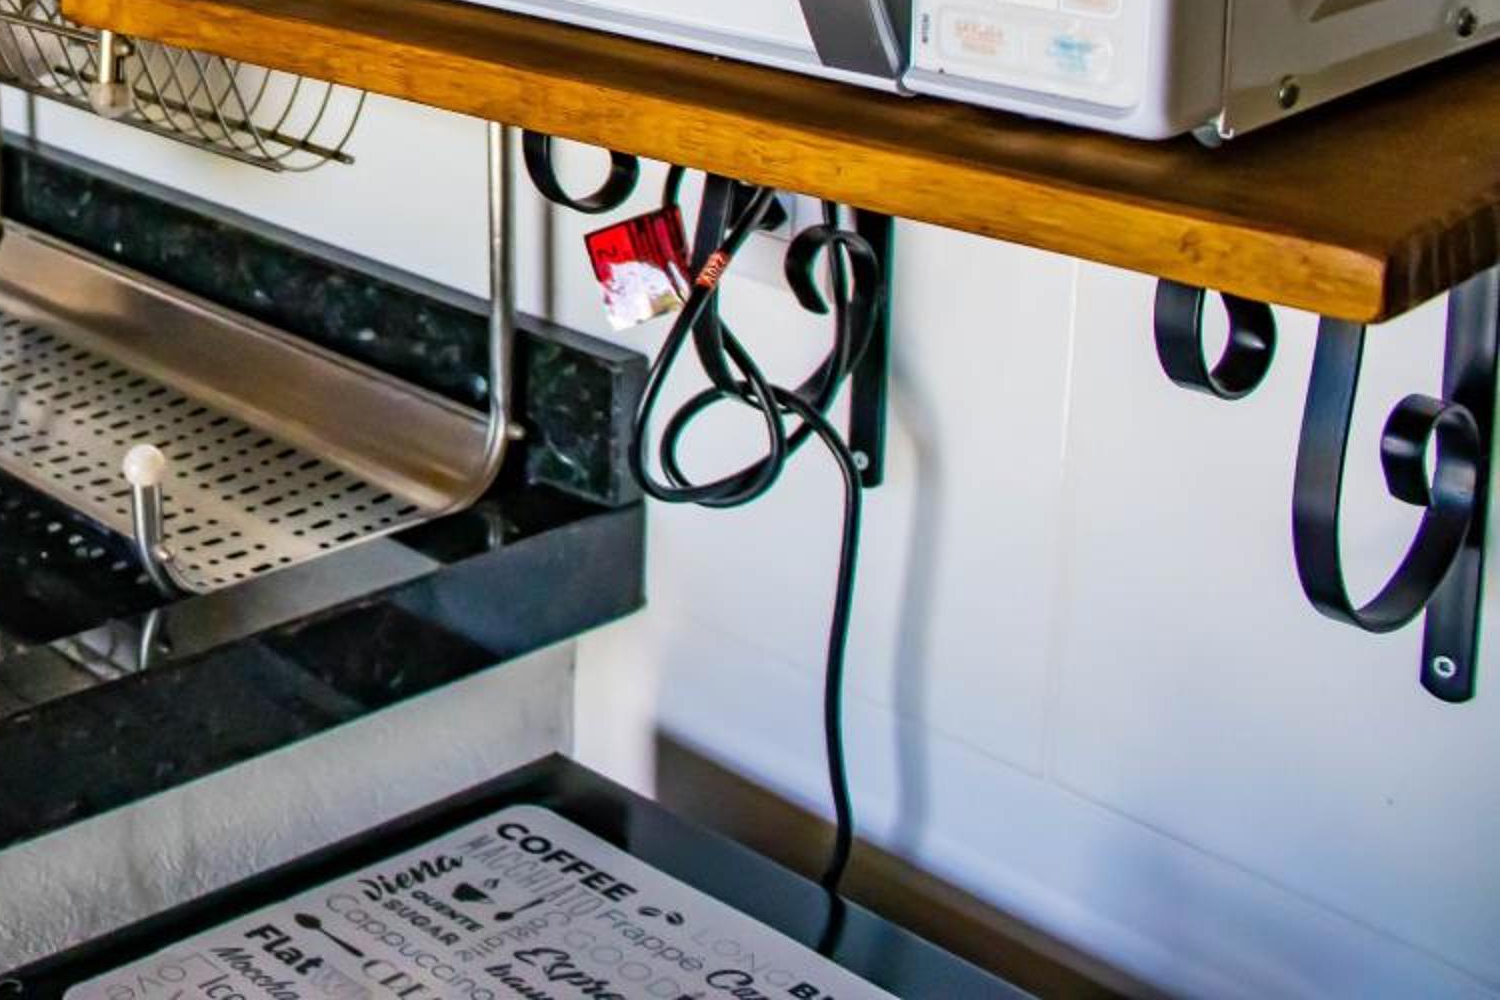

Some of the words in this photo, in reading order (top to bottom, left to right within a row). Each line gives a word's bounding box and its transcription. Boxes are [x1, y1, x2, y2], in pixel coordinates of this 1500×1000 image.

[496, 822, 638, 902] COFFEE
[243, 922, 325, 976] Flat
[325, 892, 495, 1000] Cappuccino
[382, 898, 461, 946] SUGAR
